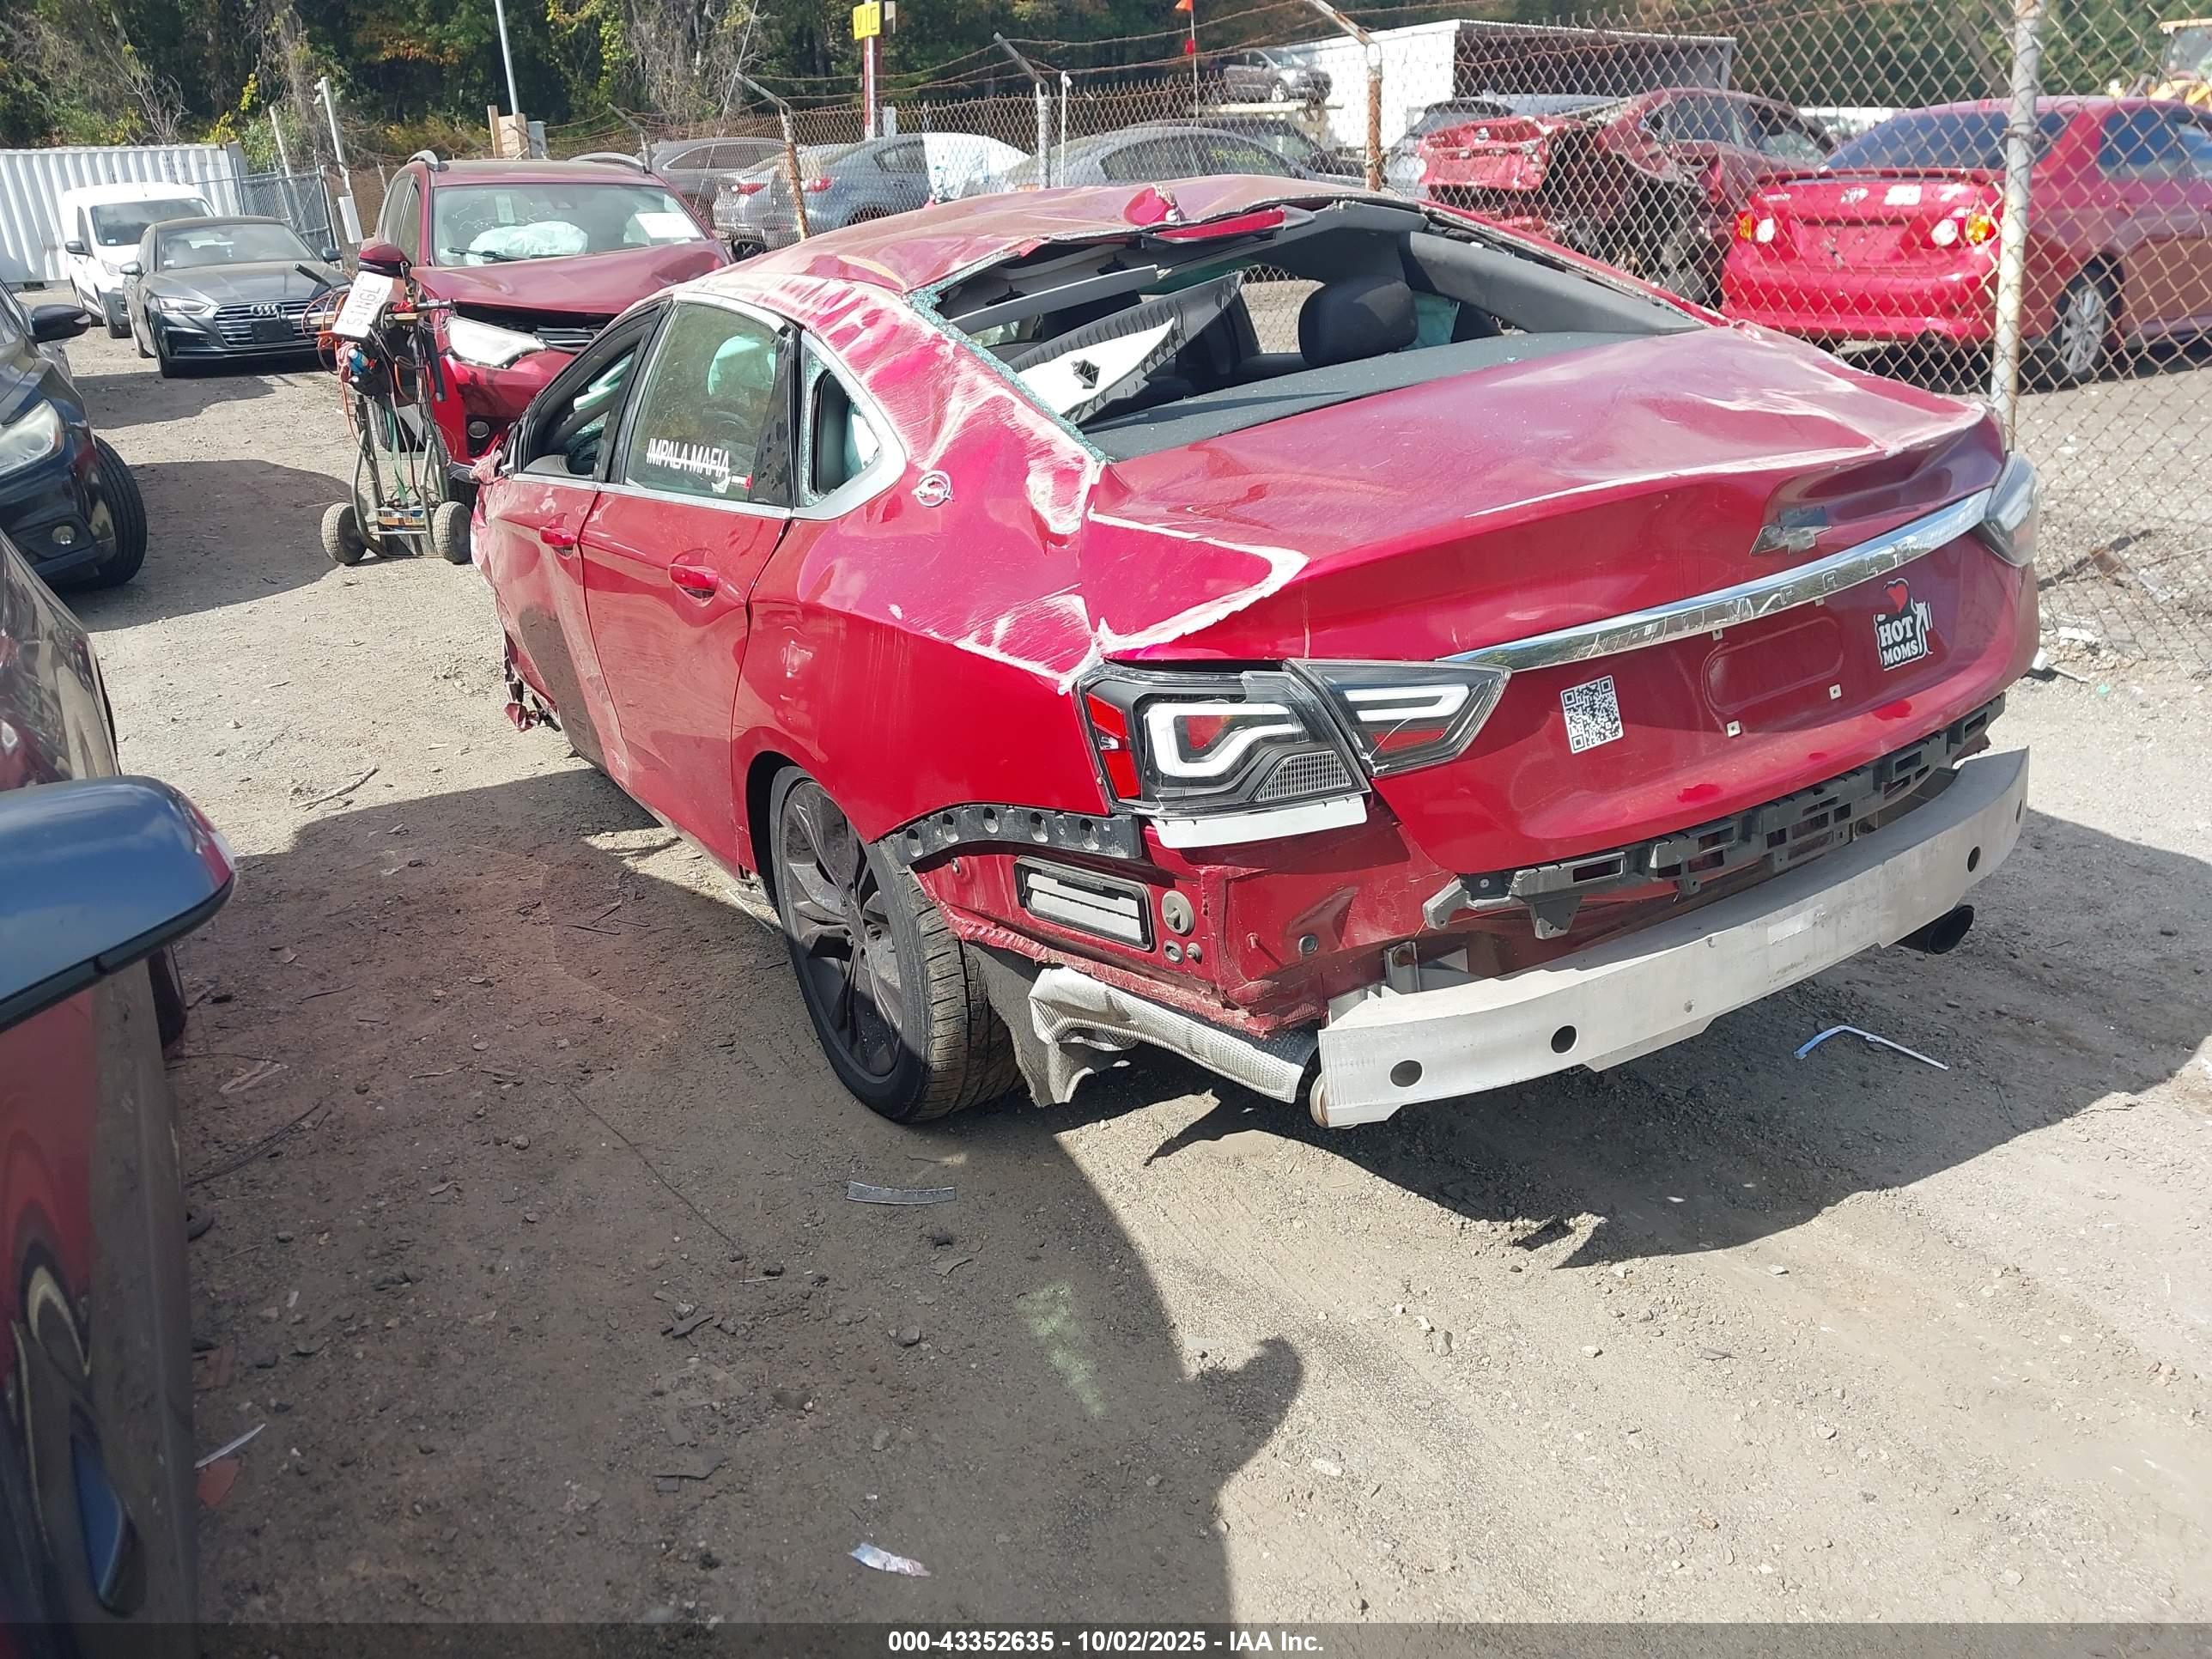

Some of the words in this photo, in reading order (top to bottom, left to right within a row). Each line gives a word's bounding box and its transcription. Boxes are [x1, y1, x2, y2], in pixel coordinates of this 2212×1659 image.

[647, 437, 690, 471] IMPALA
[689, 444, 730, 478] MAFIA
[1878, 615, 1913, 647] HOT
[1882, 639, 1919, 665] MOMS
